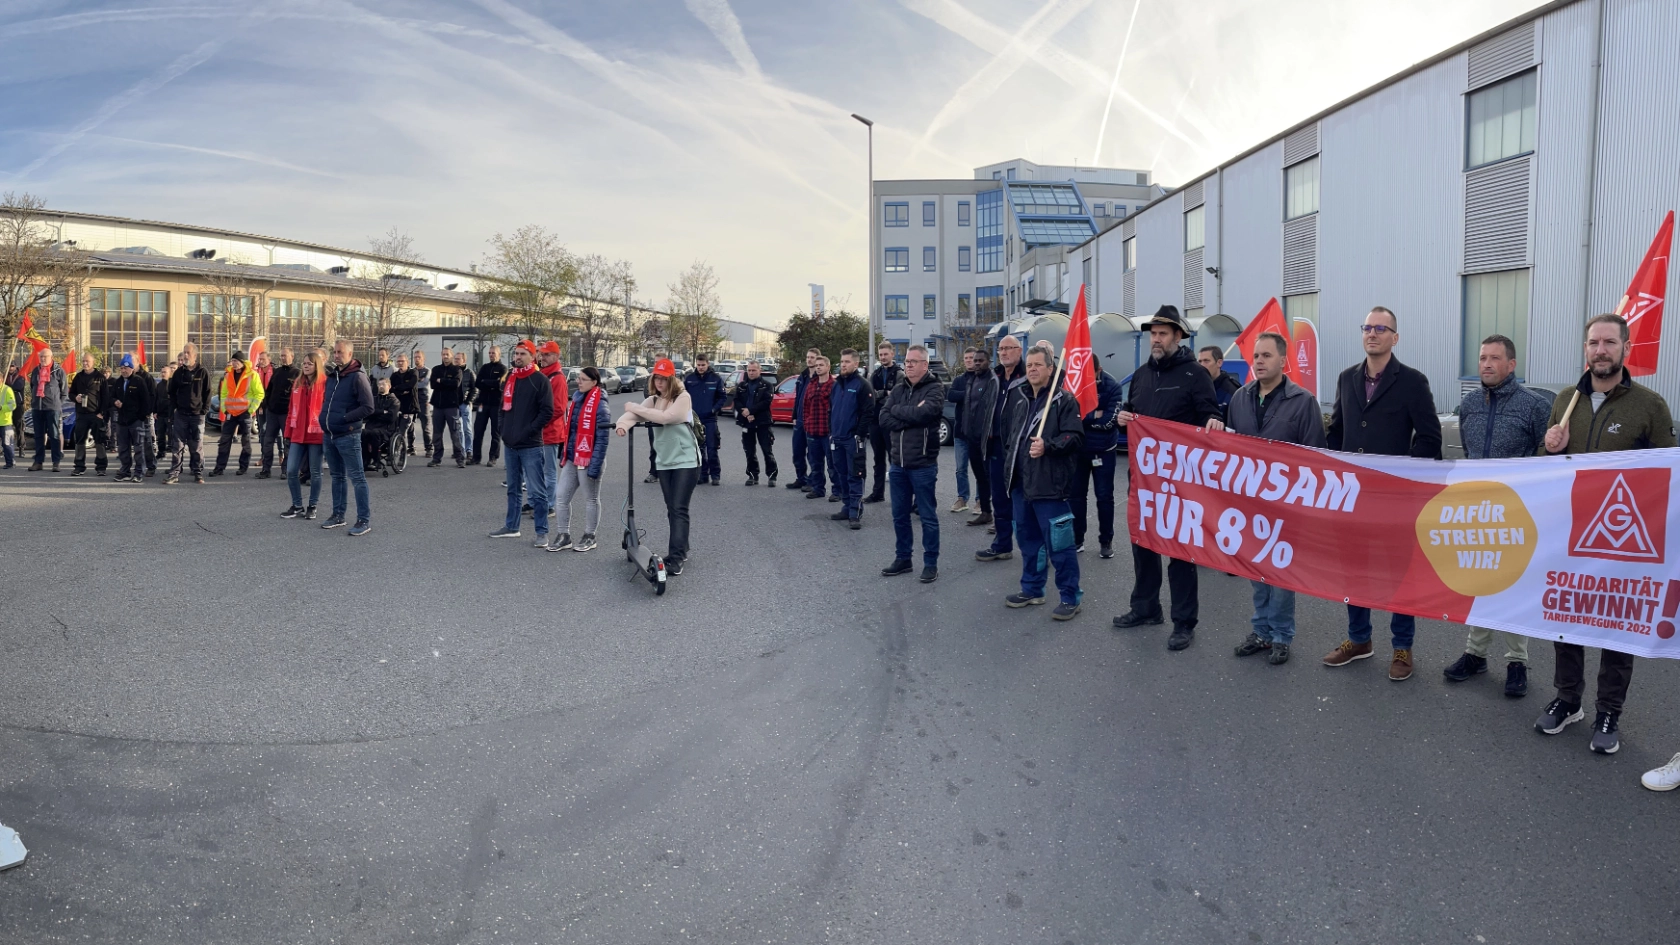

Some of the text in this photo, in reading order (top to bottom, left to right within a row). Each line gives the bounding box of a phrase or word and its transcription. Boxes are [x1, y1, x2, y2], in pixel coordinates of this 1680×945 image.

[1136, 436, 1360, 512] GEMEINSAM
[1138, 481, 1204, 547] FÜR
[1439, 500, 1505, 523] DAFÜR
[1429, 528, 1525, 546] STREITEN
[1456, 550, 1502, 570] WIR!
[1545, 570, 1664, 598] SOLIDARITÄT
[1543, 610, 1651, 635] TARIFBEWEGUNG 2022
